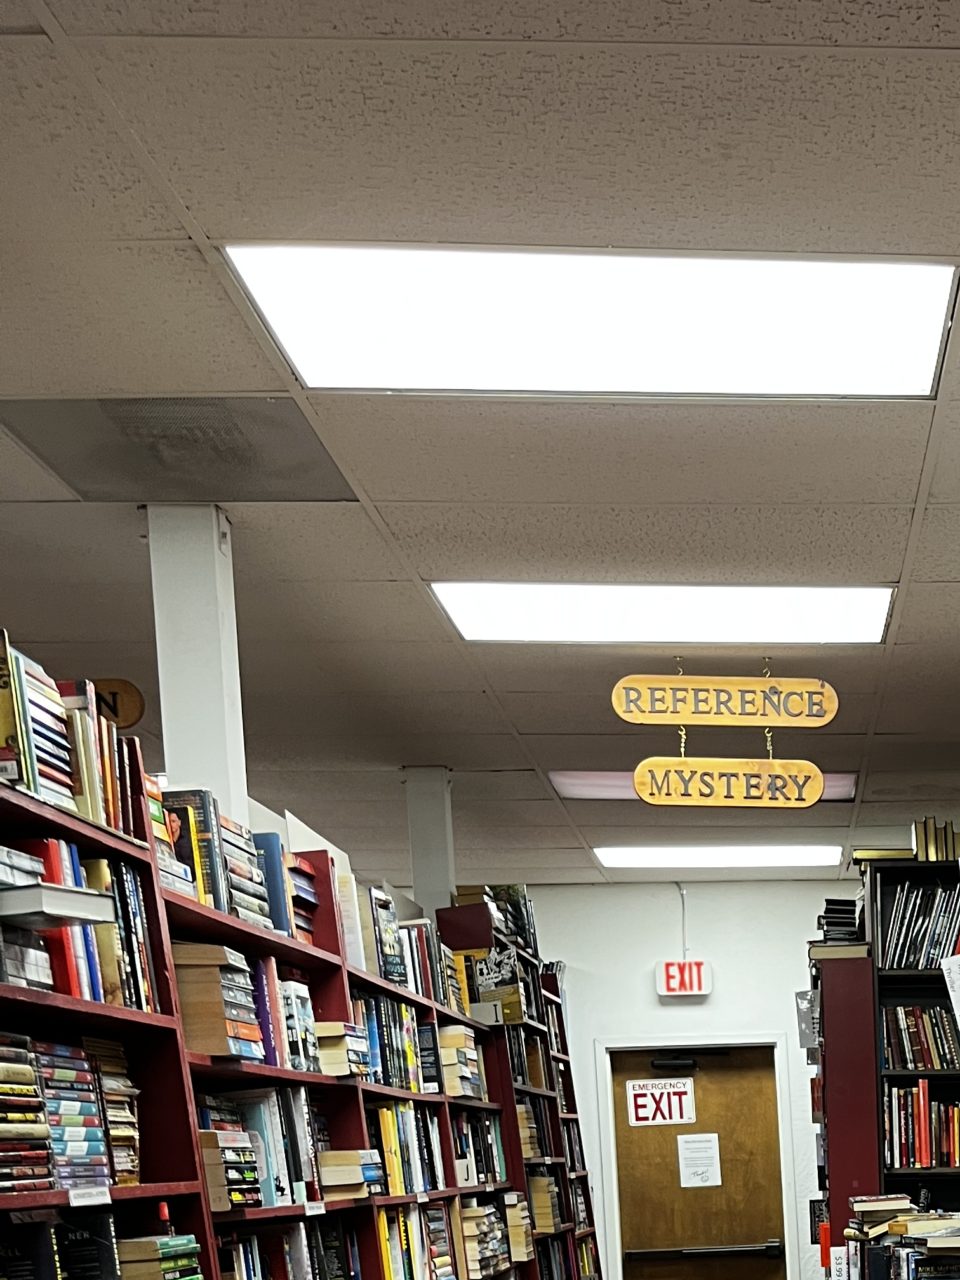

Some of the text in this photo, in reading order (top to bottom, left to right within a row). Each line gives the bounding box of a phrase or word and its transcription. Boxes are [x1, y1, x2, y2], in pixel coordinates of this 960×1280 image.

[623, 687, 826, 717] REFERENCE
[649, 769, 812, 802] MYSTERY
[387, 964, 405, 974] HOUSE
[665, 962, 703, 992] EXIT
[945, 965, 959, 994] Thriller
[633, 1082, 687, 1091] EMERGENCY
[633, 1091, 687, 1121] EXIT
[463, 1167, 471, 1182] J
